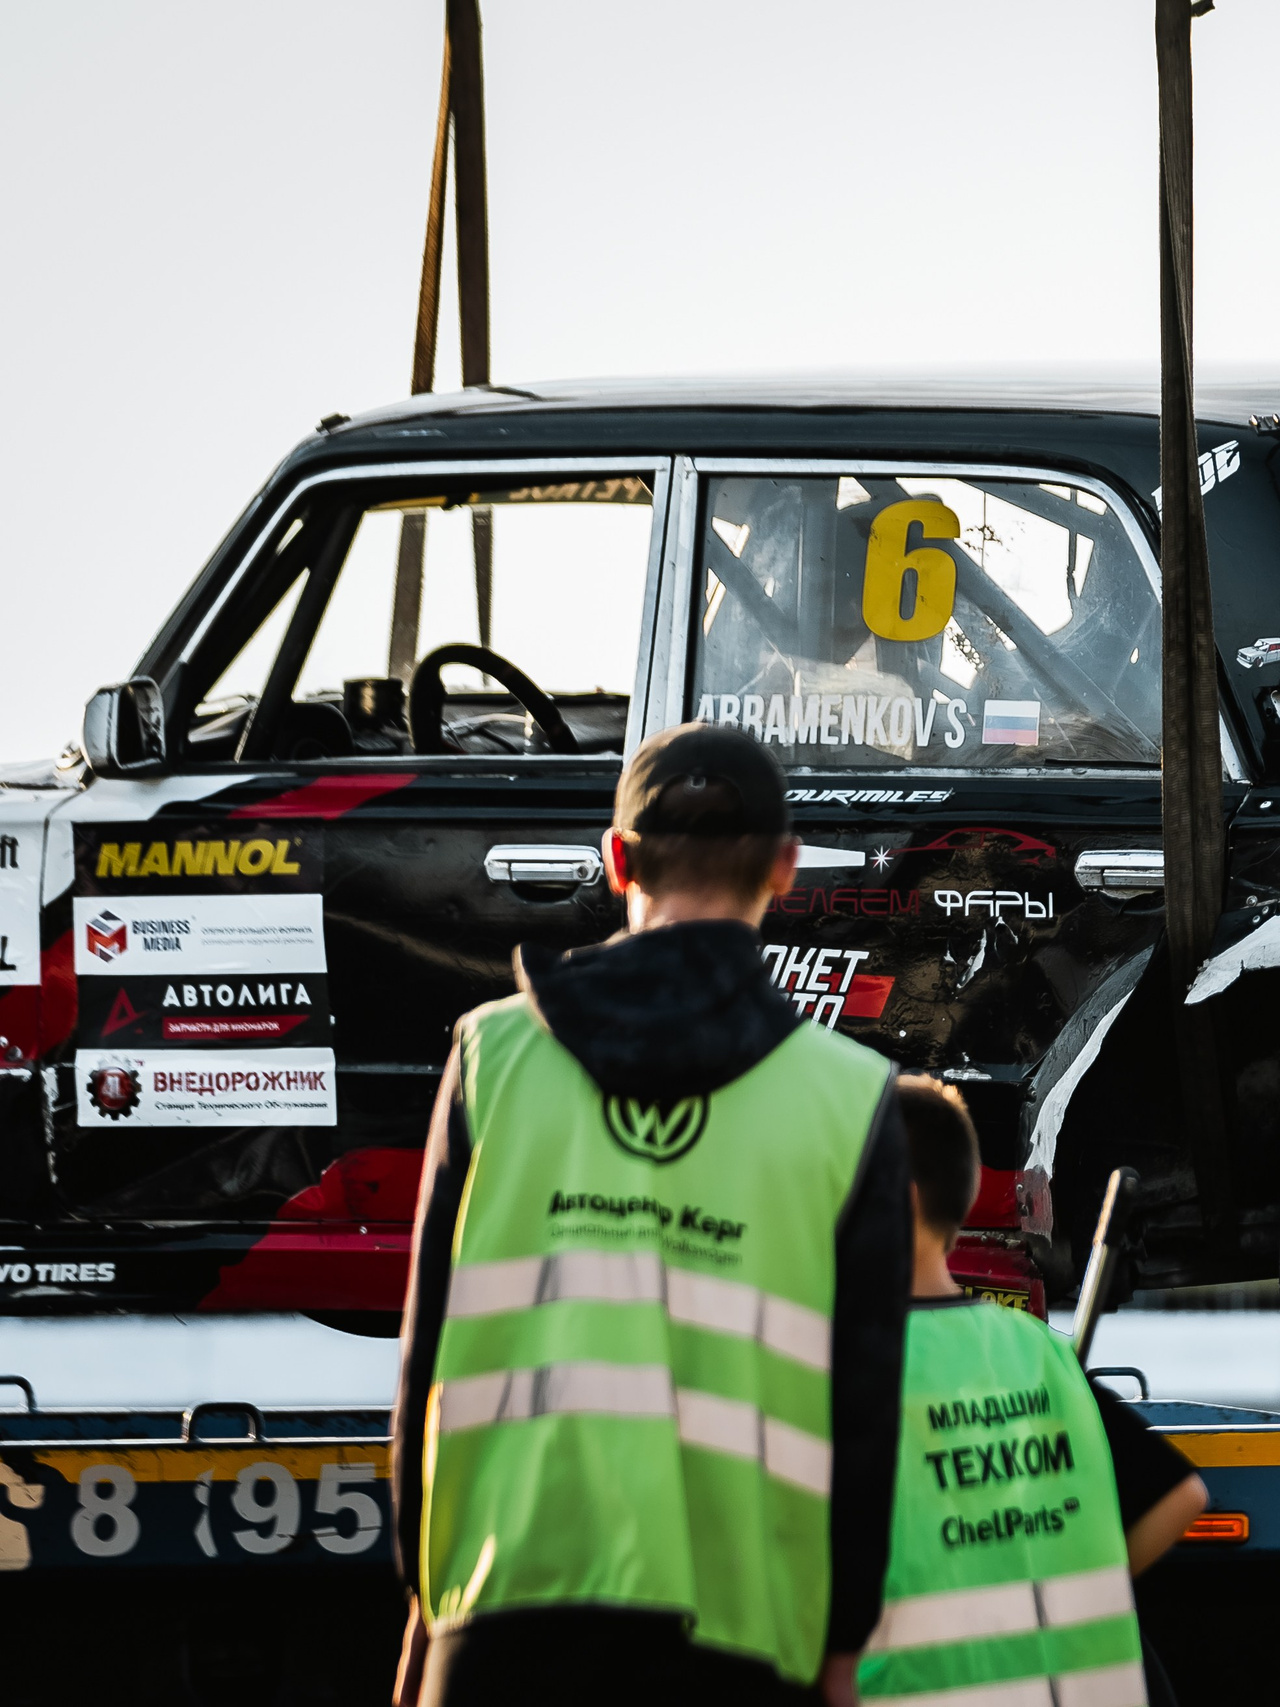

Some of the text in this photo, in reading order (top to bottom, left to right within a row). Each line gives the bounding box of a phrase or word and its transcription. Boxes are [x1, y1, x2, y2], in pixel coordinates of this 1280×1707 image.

[862, 500, 961, 642] 6
[944, 697, 968, 749] S
[96, 839, 300, 878] MANNOL
[934, 889, 1053, 918] ФАРЫ
[132, 919, 191, 935] BUSINESS
[143, 937, 183, 951] MEDIA
[162, 982, 312, 1008] АВТОЛИГА
[153, 1070, 327, 1096] ВНЕДОРОЖНИК
[36, 1263, 116, 1283] TIRES
[927, 1386, 1050, 1430] МЛАДШИЙ
[926, 1430, 1075, 1490] ТЕХКОМ
